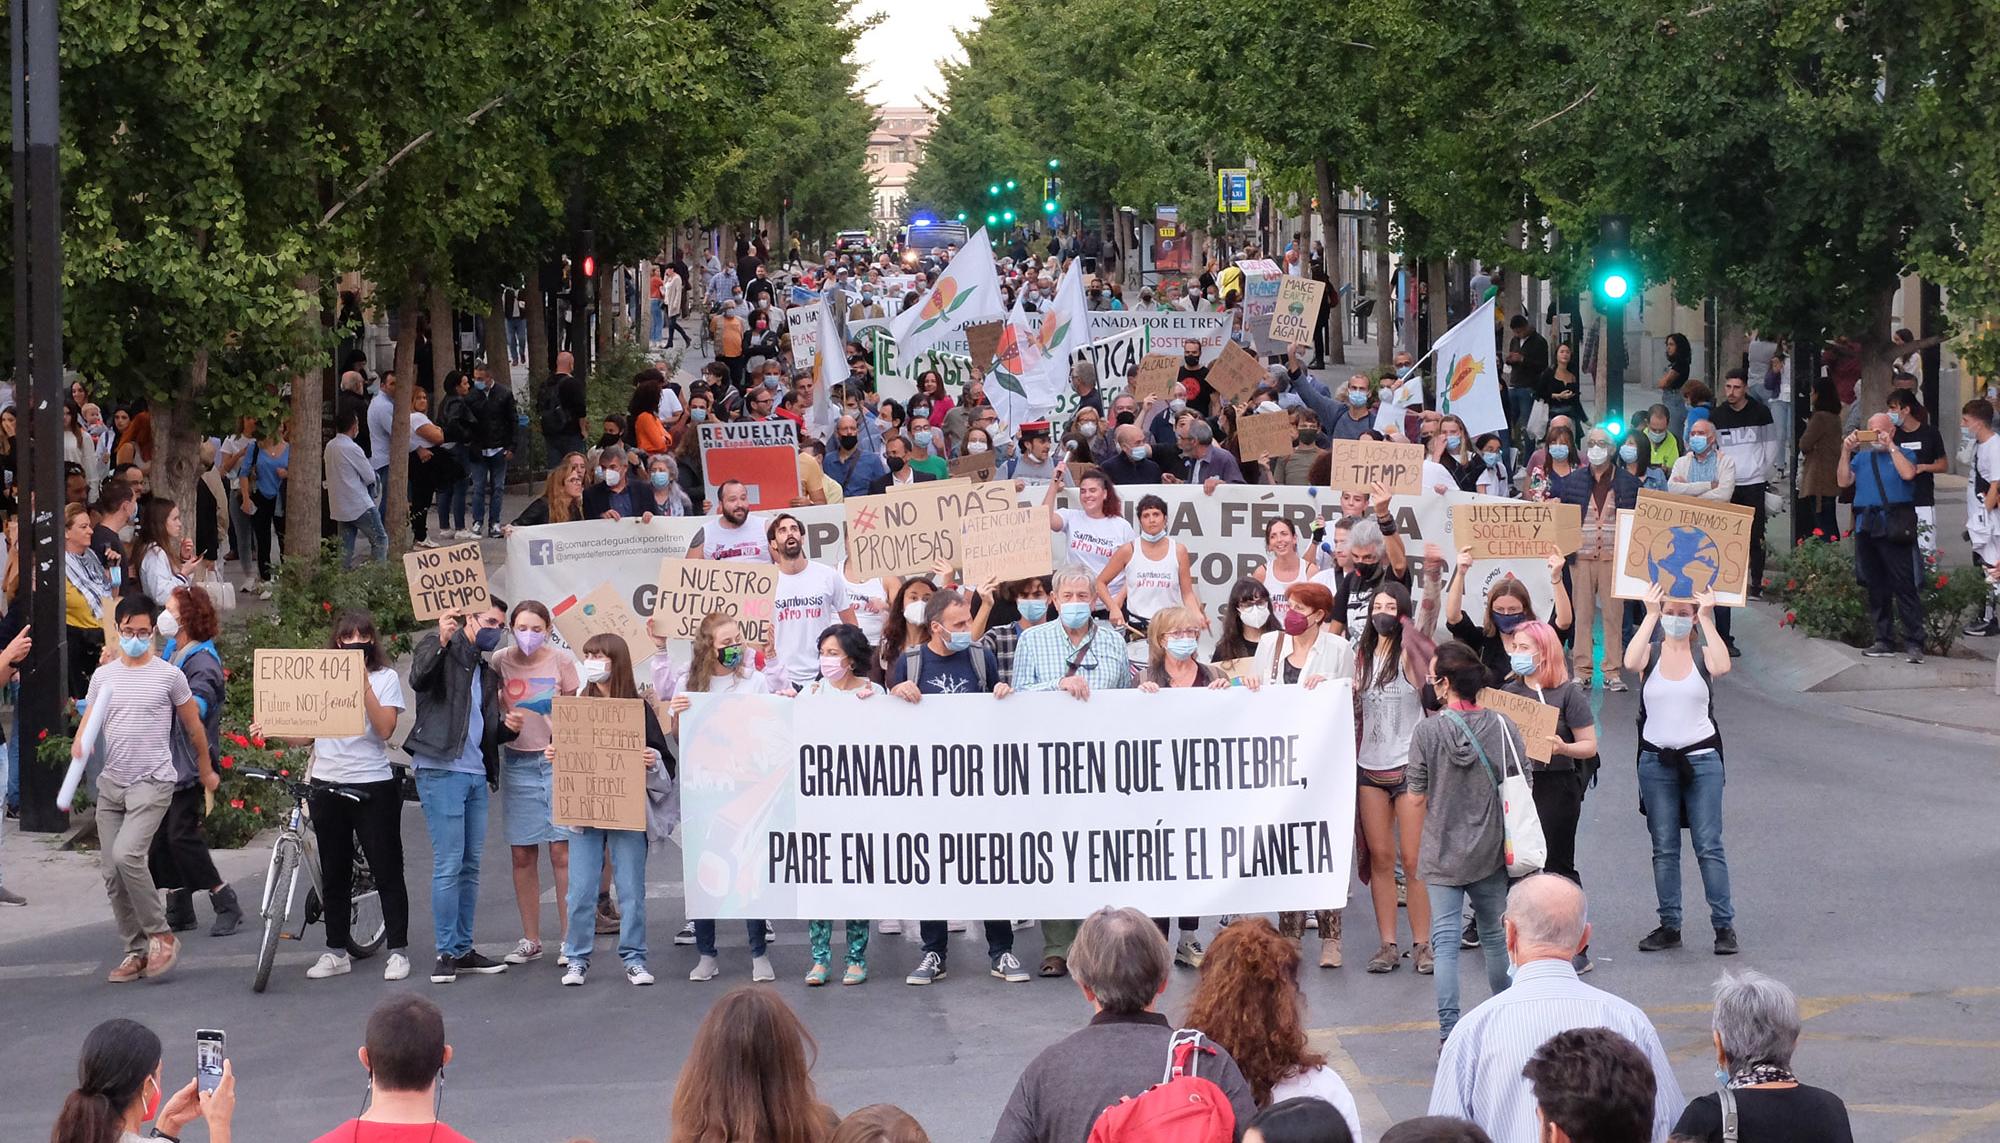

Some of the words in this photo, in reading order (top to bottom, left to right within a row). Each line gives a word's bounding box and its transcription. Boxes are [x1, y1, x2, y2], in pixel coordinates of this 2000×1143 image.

[1285, 279, 1315, 294] MAKE
[1282, 291, 1315, 303] EARTH
[789, 313, 801, 326] NO
[1091, 316, 1138, 328] ANADA
[1173, 317, 1187, 328] EL
[1189, 317, 1224, 328] TREN
[1276, 314, 1307, 328] COOL
[792, 331, 816, 346] PLANE
[1273, 325, 1310, 343] AGAIN
[701, 423, 794, 441] REVUELTA
[1721, 428, 1757, 445] FILA
[703, 440, 713, 449] de
[714, 440, 723, 448] la
[936, 485, 1011, 522] MÁS
[1469, 505, 1553, 524] JUSTICIA
[1637, 502, 1673, 522] SOLO
[1679, 509, 1728, 531] TENEMOS
[1732, 519, 1744, 536] 1
[1472, 524, 1526, 540] SOCIAL
[1532, 524, 1541, 539] Y
[416, 553, 441, 570] NO
[448, 544, 480, 563] NOS
[853, 529, 955, 573] PROMESAS
[420, 566, 478, 590] QUEDA
[680, 566, 772, 595] NUESTRO
[416, 585, 487, 613] TIEMPO
[659, 589, 738, 617] FUTURO
[743, 598, 772, 618] NO
[261, 656, 316, 680] ERROR
[319, 656, 351, 682] 404
[257, 690, 291, 713] Future
[296, 693, 320, 712] NOT
[319, 690, 358, 722] found
[559, 705, 579, 722] NO
[587, 704, 627, 723] QUIERO
[558, 728, 581, 745] QUE
[592, 728, 642, 749] RESPIRAR
[558, 752, 597, 772] HONDO
[605, 751, 626, 771] SEA
[800, 743, 923, 797] GRANADA
[932, 743, 984, 797] POR
[993, 743, 1029, 796] UN
[1038, 740, 1107, 795] TREN
[1115, 739, 1164, 796] QUE
[1171, 734, 1308, 791] VERTEBRE,
[559, 776, 575, 793] UN
[585, 776, 627, 795] DEPORTE
[560, 796, 571, 817] DE
[768, 831, 833, 884] PARE
[842, 832, 874, 884] EN
[883, 832, 930, 884] LOS
[939, 831, 1054, 885] PUEBLOS
[1062, 830, 1079, 883] Y
[1088, 818, 1177, 883] ENFRÍE
[1185, 827, 1213, 880] EL
[1221, 820, 1334, 879] PLANETA
